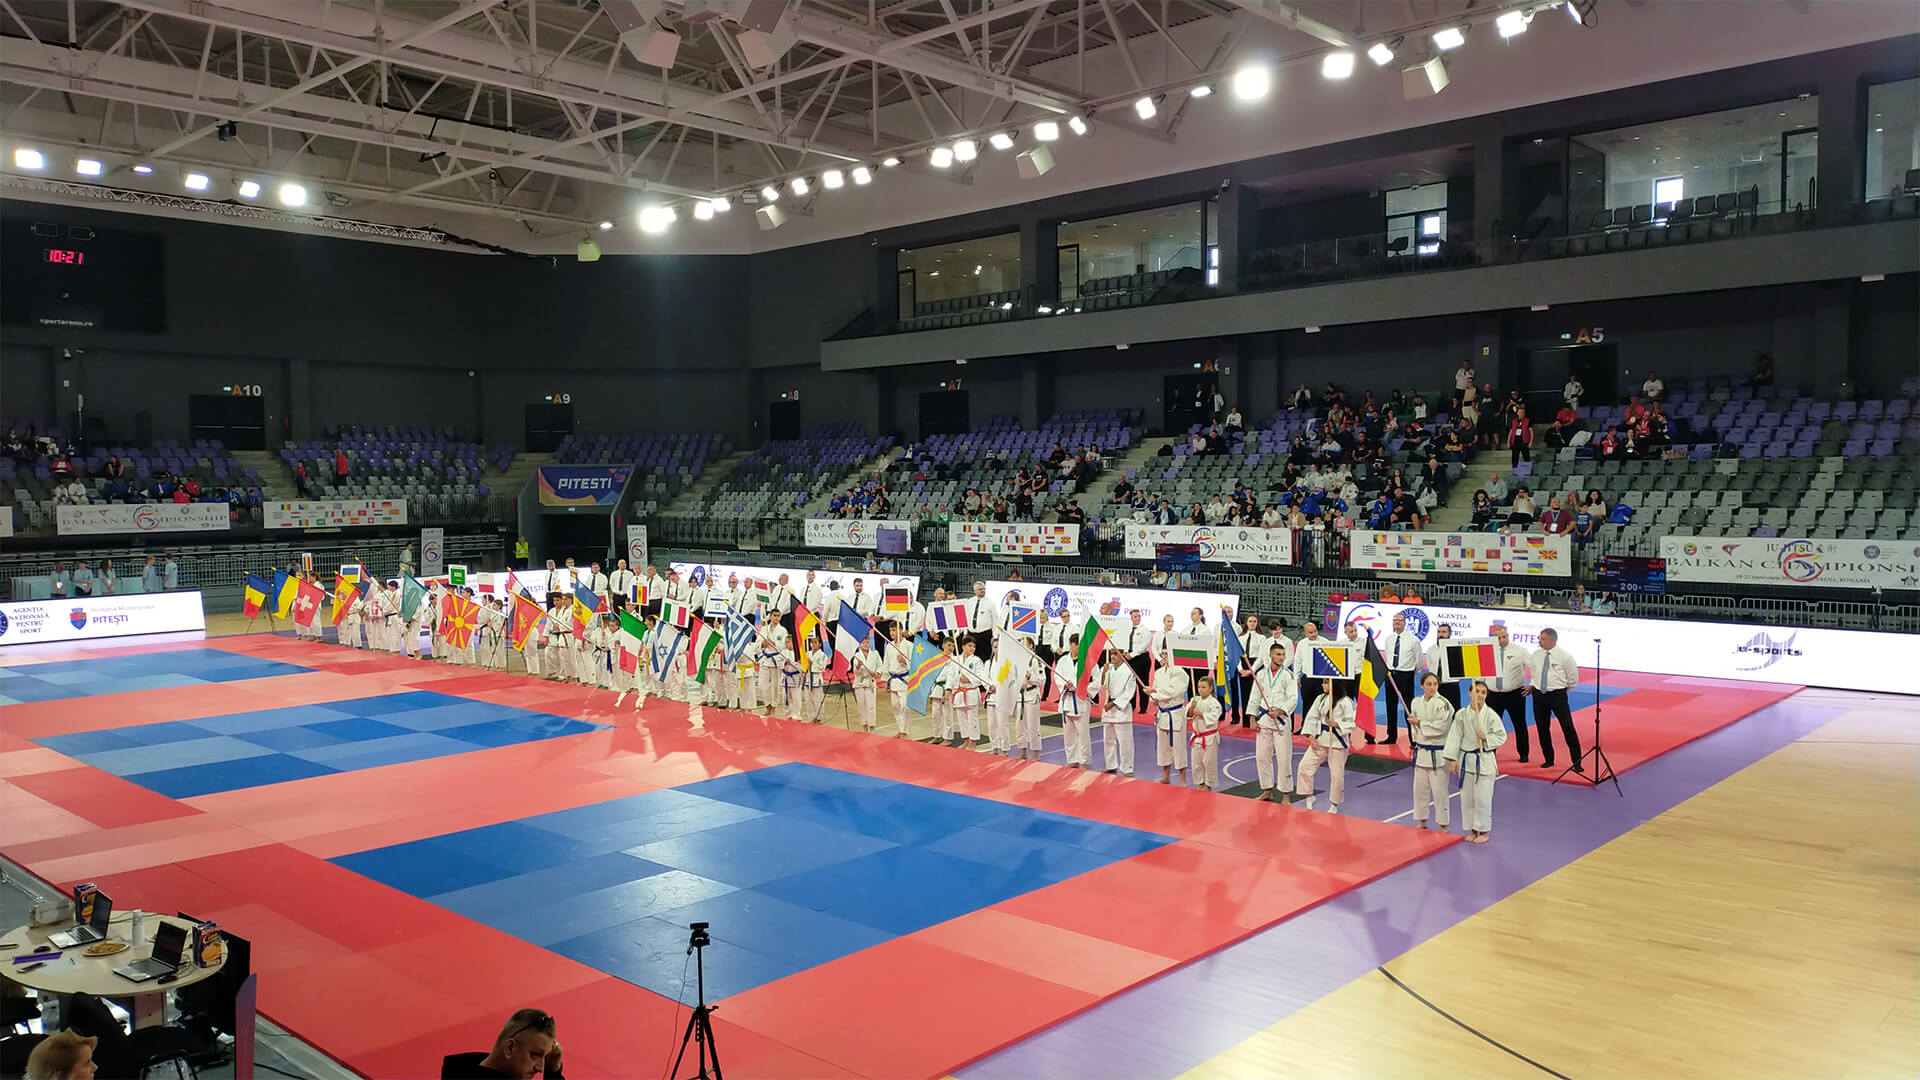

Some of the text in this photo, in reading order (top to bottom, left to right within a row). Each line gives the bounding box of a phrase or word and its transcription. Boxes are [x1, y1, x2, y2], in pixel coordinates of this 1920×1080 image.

[49, 249, 84, 265] 10:21
[1575, 327, 1605, 343] A5
[231, 384, 262, 397] A10
[553, 393, 570, 404] A9
[558, 477, 613, 490] PITESTI
[1667, 557, 1754, 569] BALKAN
